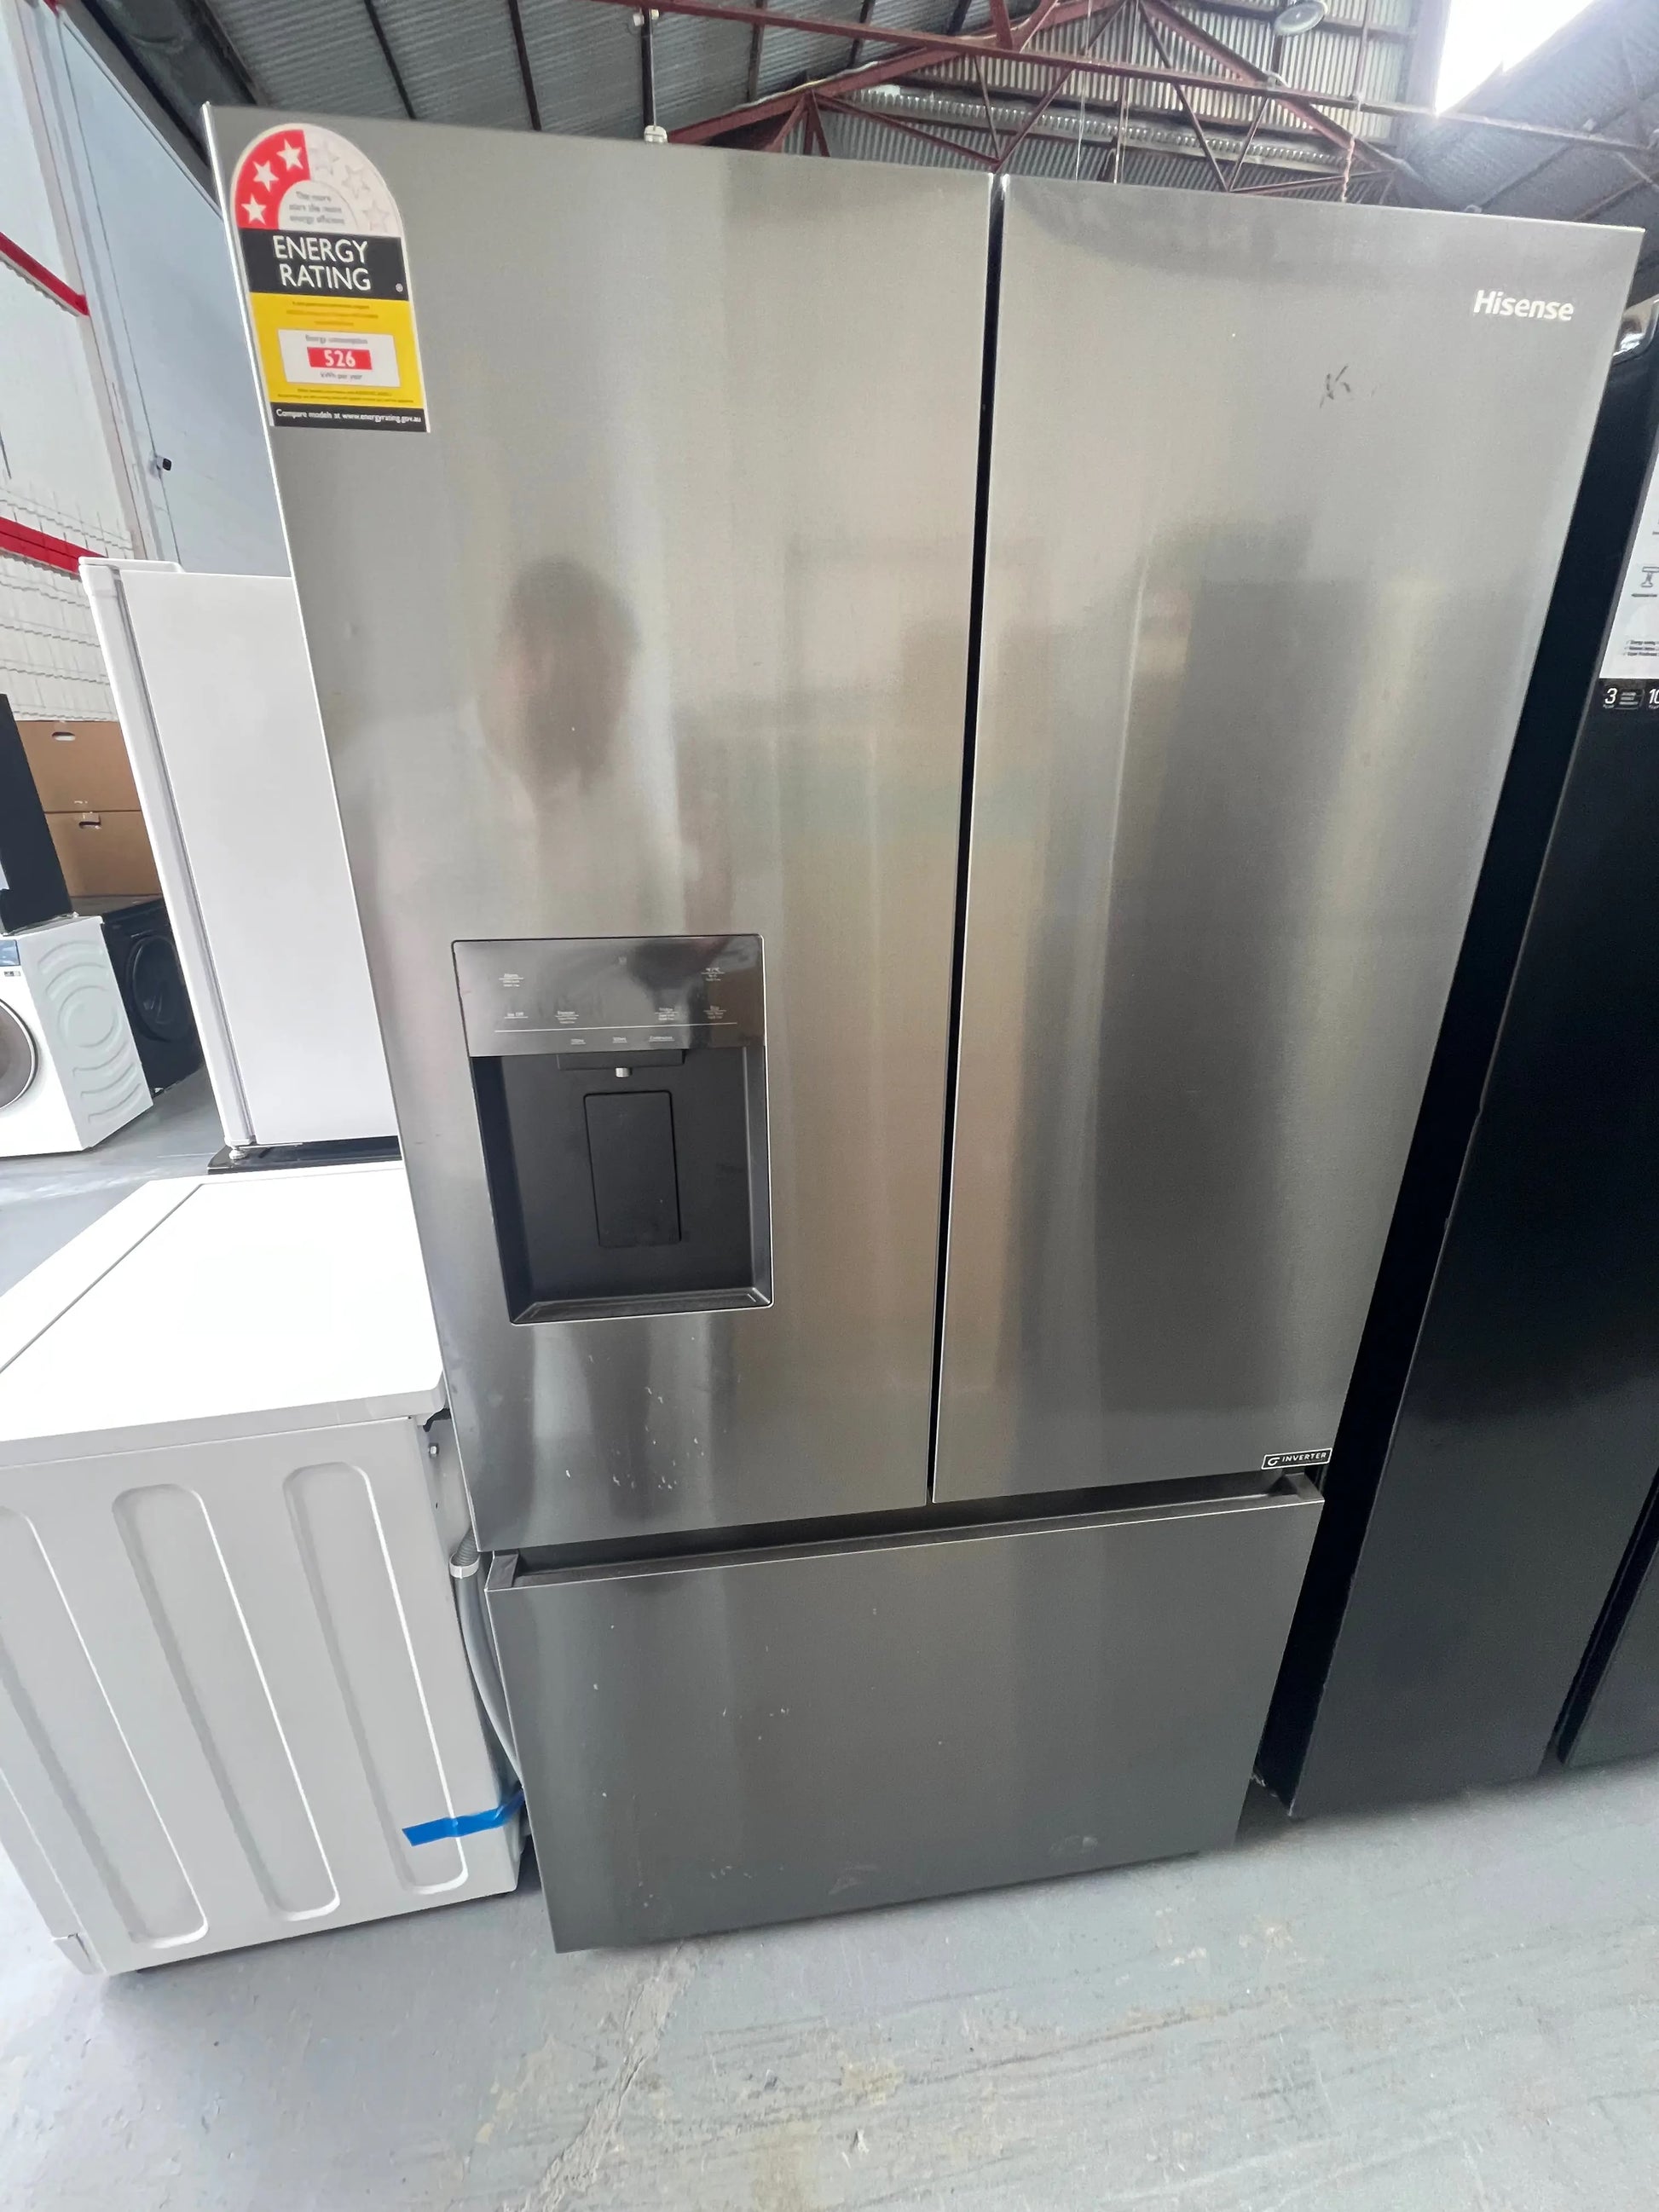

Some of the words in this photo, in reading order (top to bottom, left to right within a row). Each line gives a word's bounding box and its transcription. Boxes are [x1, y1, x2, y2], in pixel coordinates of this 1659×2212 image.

[272, 235, 368, 264] ENERGY
[279, 263, 372, 292] RATING
[1473, 289, 1575, 321] Hisense
[324, 349, 356, 367] 526
[275, 408, 309, 419] Compare
[309, 411, 332, 419] models
[342, 413, 422, 424] www.energyrating.gov.au
[1604, 687, 1617, 704] 3
[1282, 1452, 1327, 1462] INVERTER
